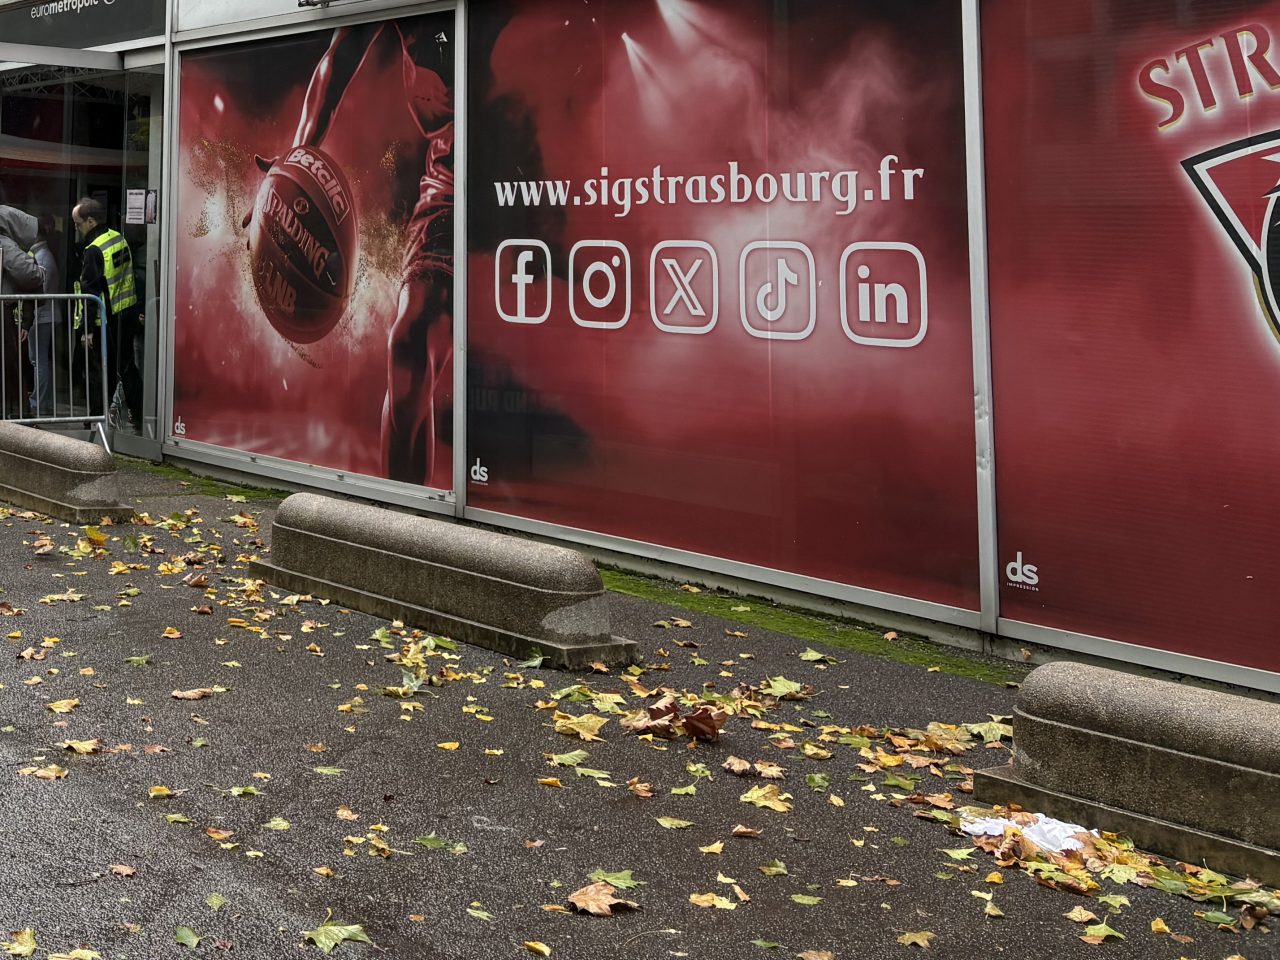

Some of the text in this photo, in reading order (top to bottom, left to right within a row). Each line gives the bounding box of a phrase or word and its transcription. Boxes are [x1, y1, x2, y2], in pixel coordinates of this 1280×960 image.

[287, 149, 345, 215] Betclic
[494, 154, 925, 218] www.sigstrasbourg.fr
[263, 187, 329, 281] SPALDING
[174, 415, 186, 435] ds
[470, 457, 489, 481] ds
[1006, 551, 1039, 585] ds
